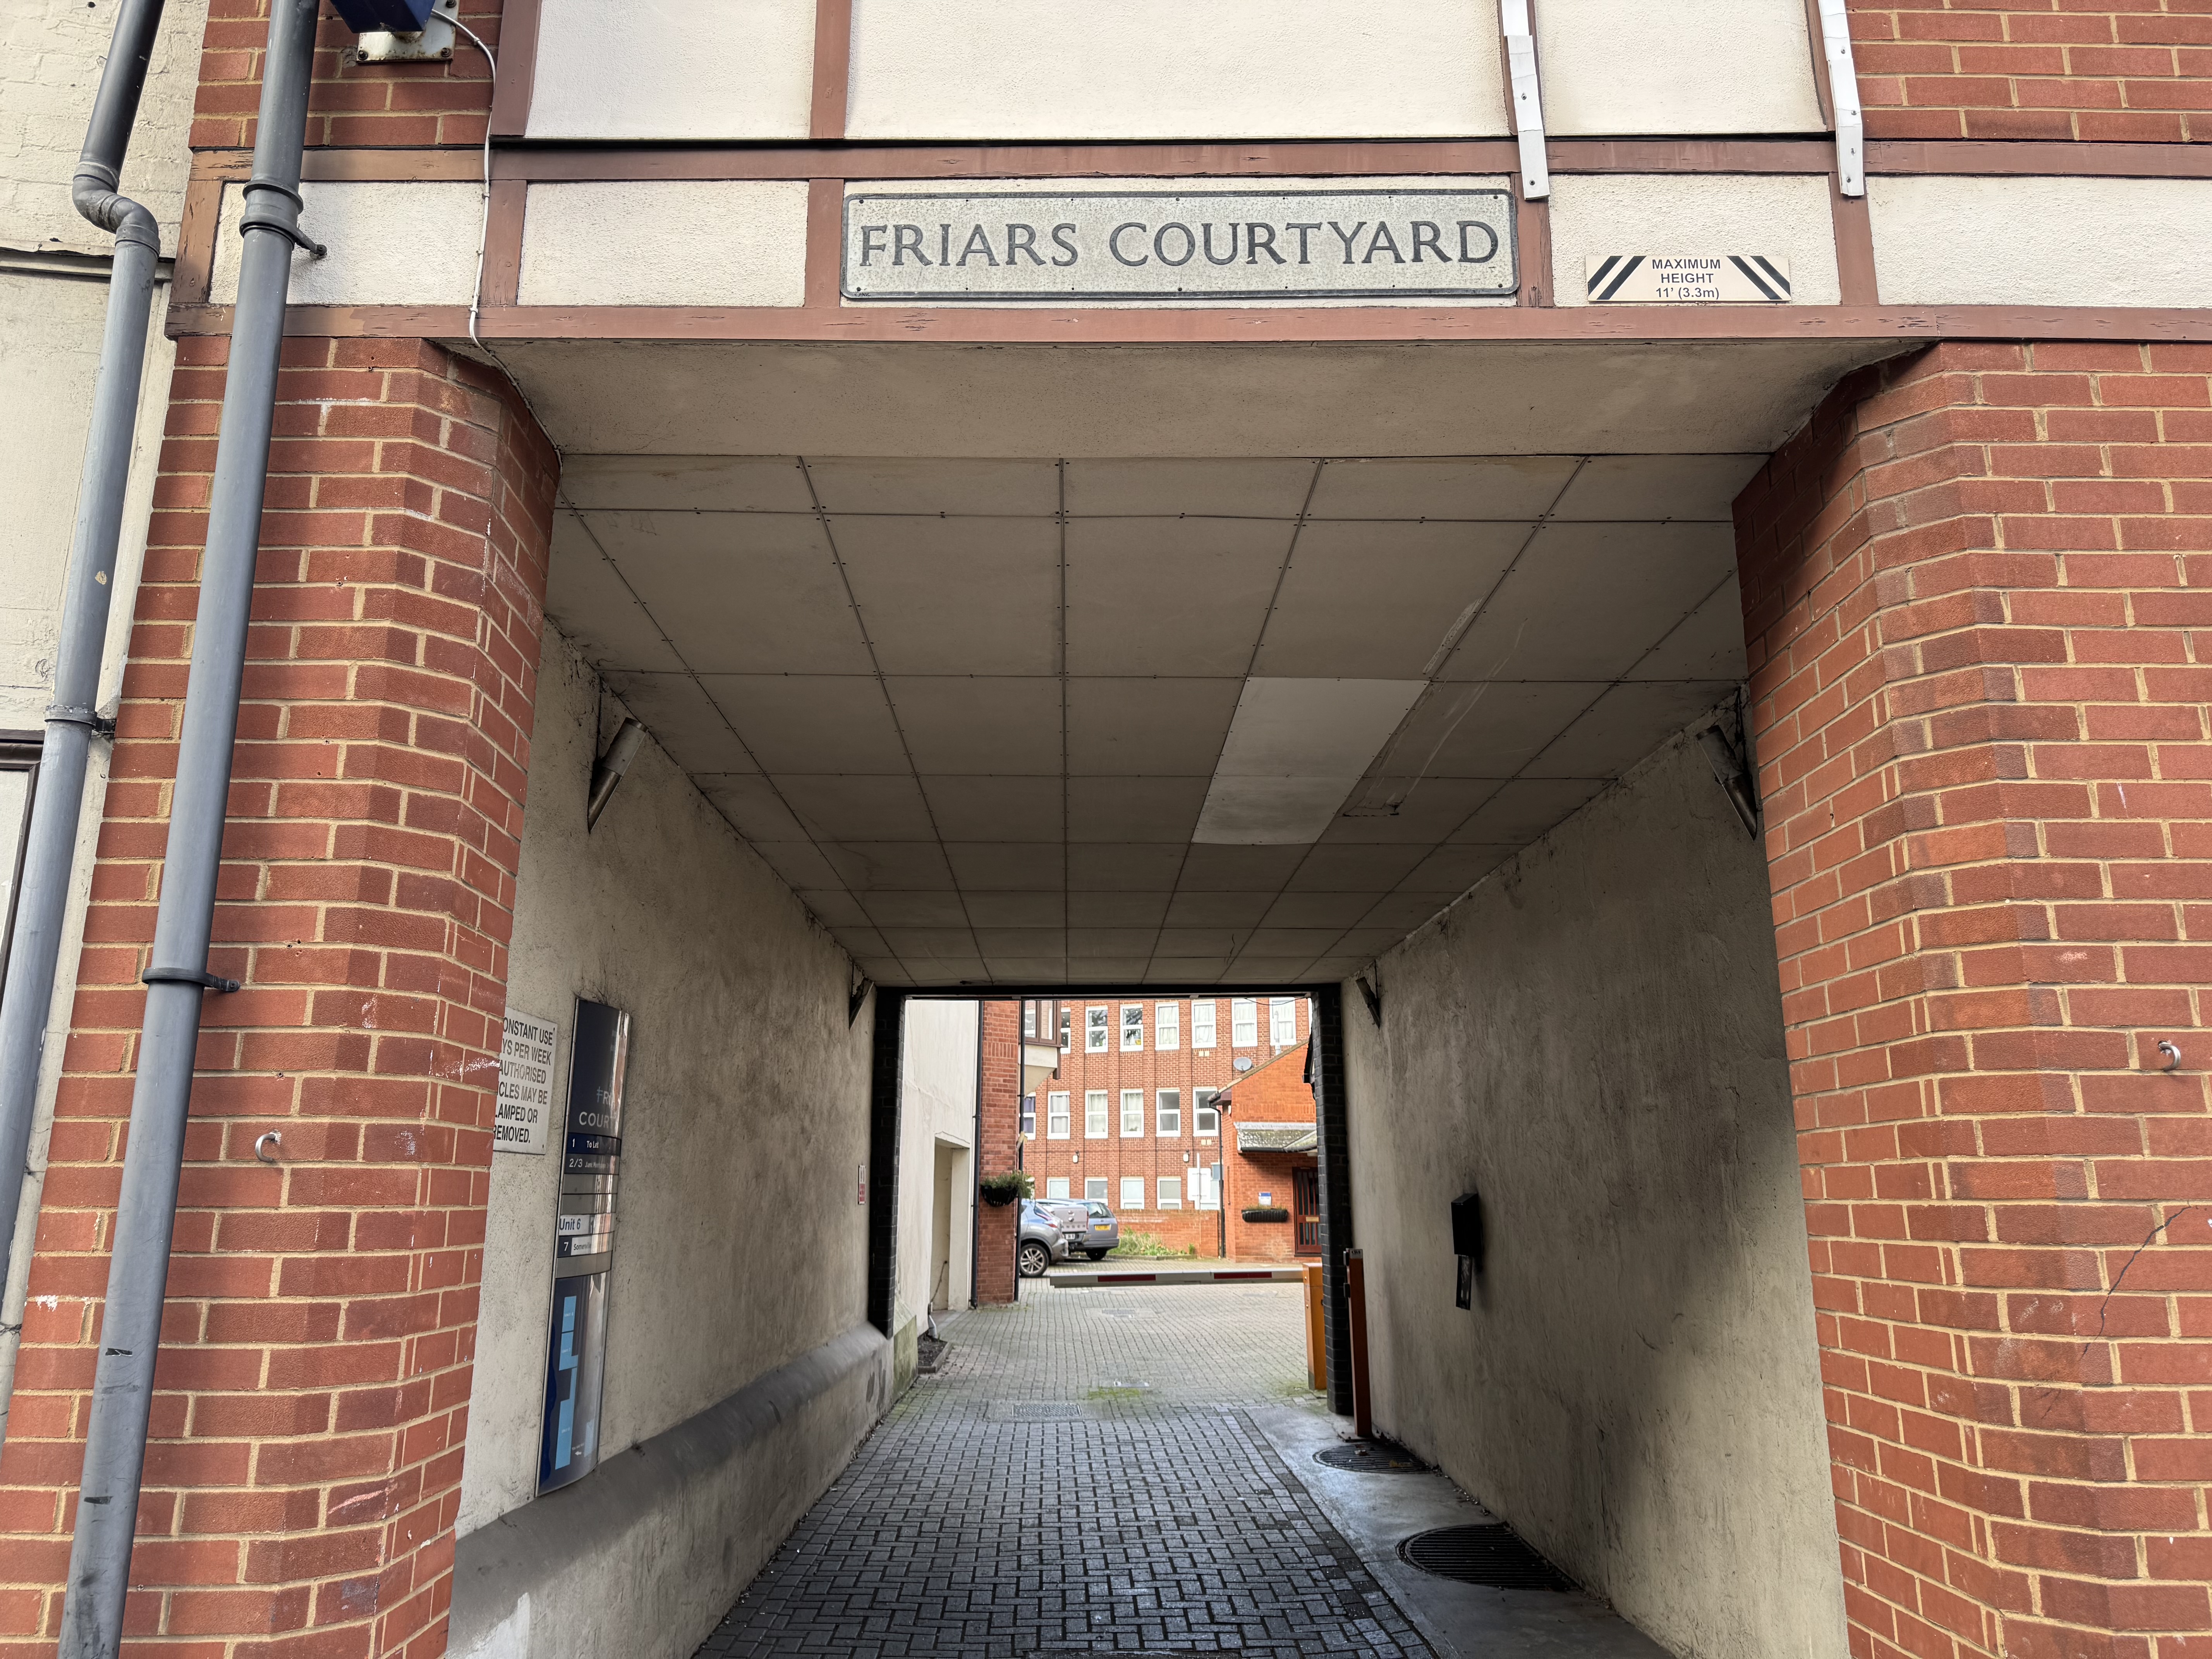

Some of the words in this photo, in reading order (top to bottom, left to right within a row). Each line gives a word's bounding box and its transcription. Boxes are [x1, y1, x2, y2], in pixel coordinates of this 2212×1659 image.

[860, 223, 1078, 266] FRIARS
[1109, 221, 1498, 266] COURTYARD
[1652, 259, 1721, 269] MAXIMUM
[1661, 273, 1714, 283] HEIGHT
[1678, 287, 1719, 300] (3.3m)
[539, 1029, 553, 1046] USE
[514, 1042, 529, 1060] PER
[532, 1047, 551, 1065] WEEK
[521, 1086, 537, 1103] MAY
[538, 1090, 547, 1104] BE
[495, 1104, 526, 1121] AMPED
[527, 1108, 538, 1123] OR
[573, 1139, 575, 1147] 1
[569, 1158, 582, 1168] 2/3
[560, 1218, 575, 1230] Unit
[577, 1218, 580, 1230] 6
[564, 1242, 568, 1251] 7
